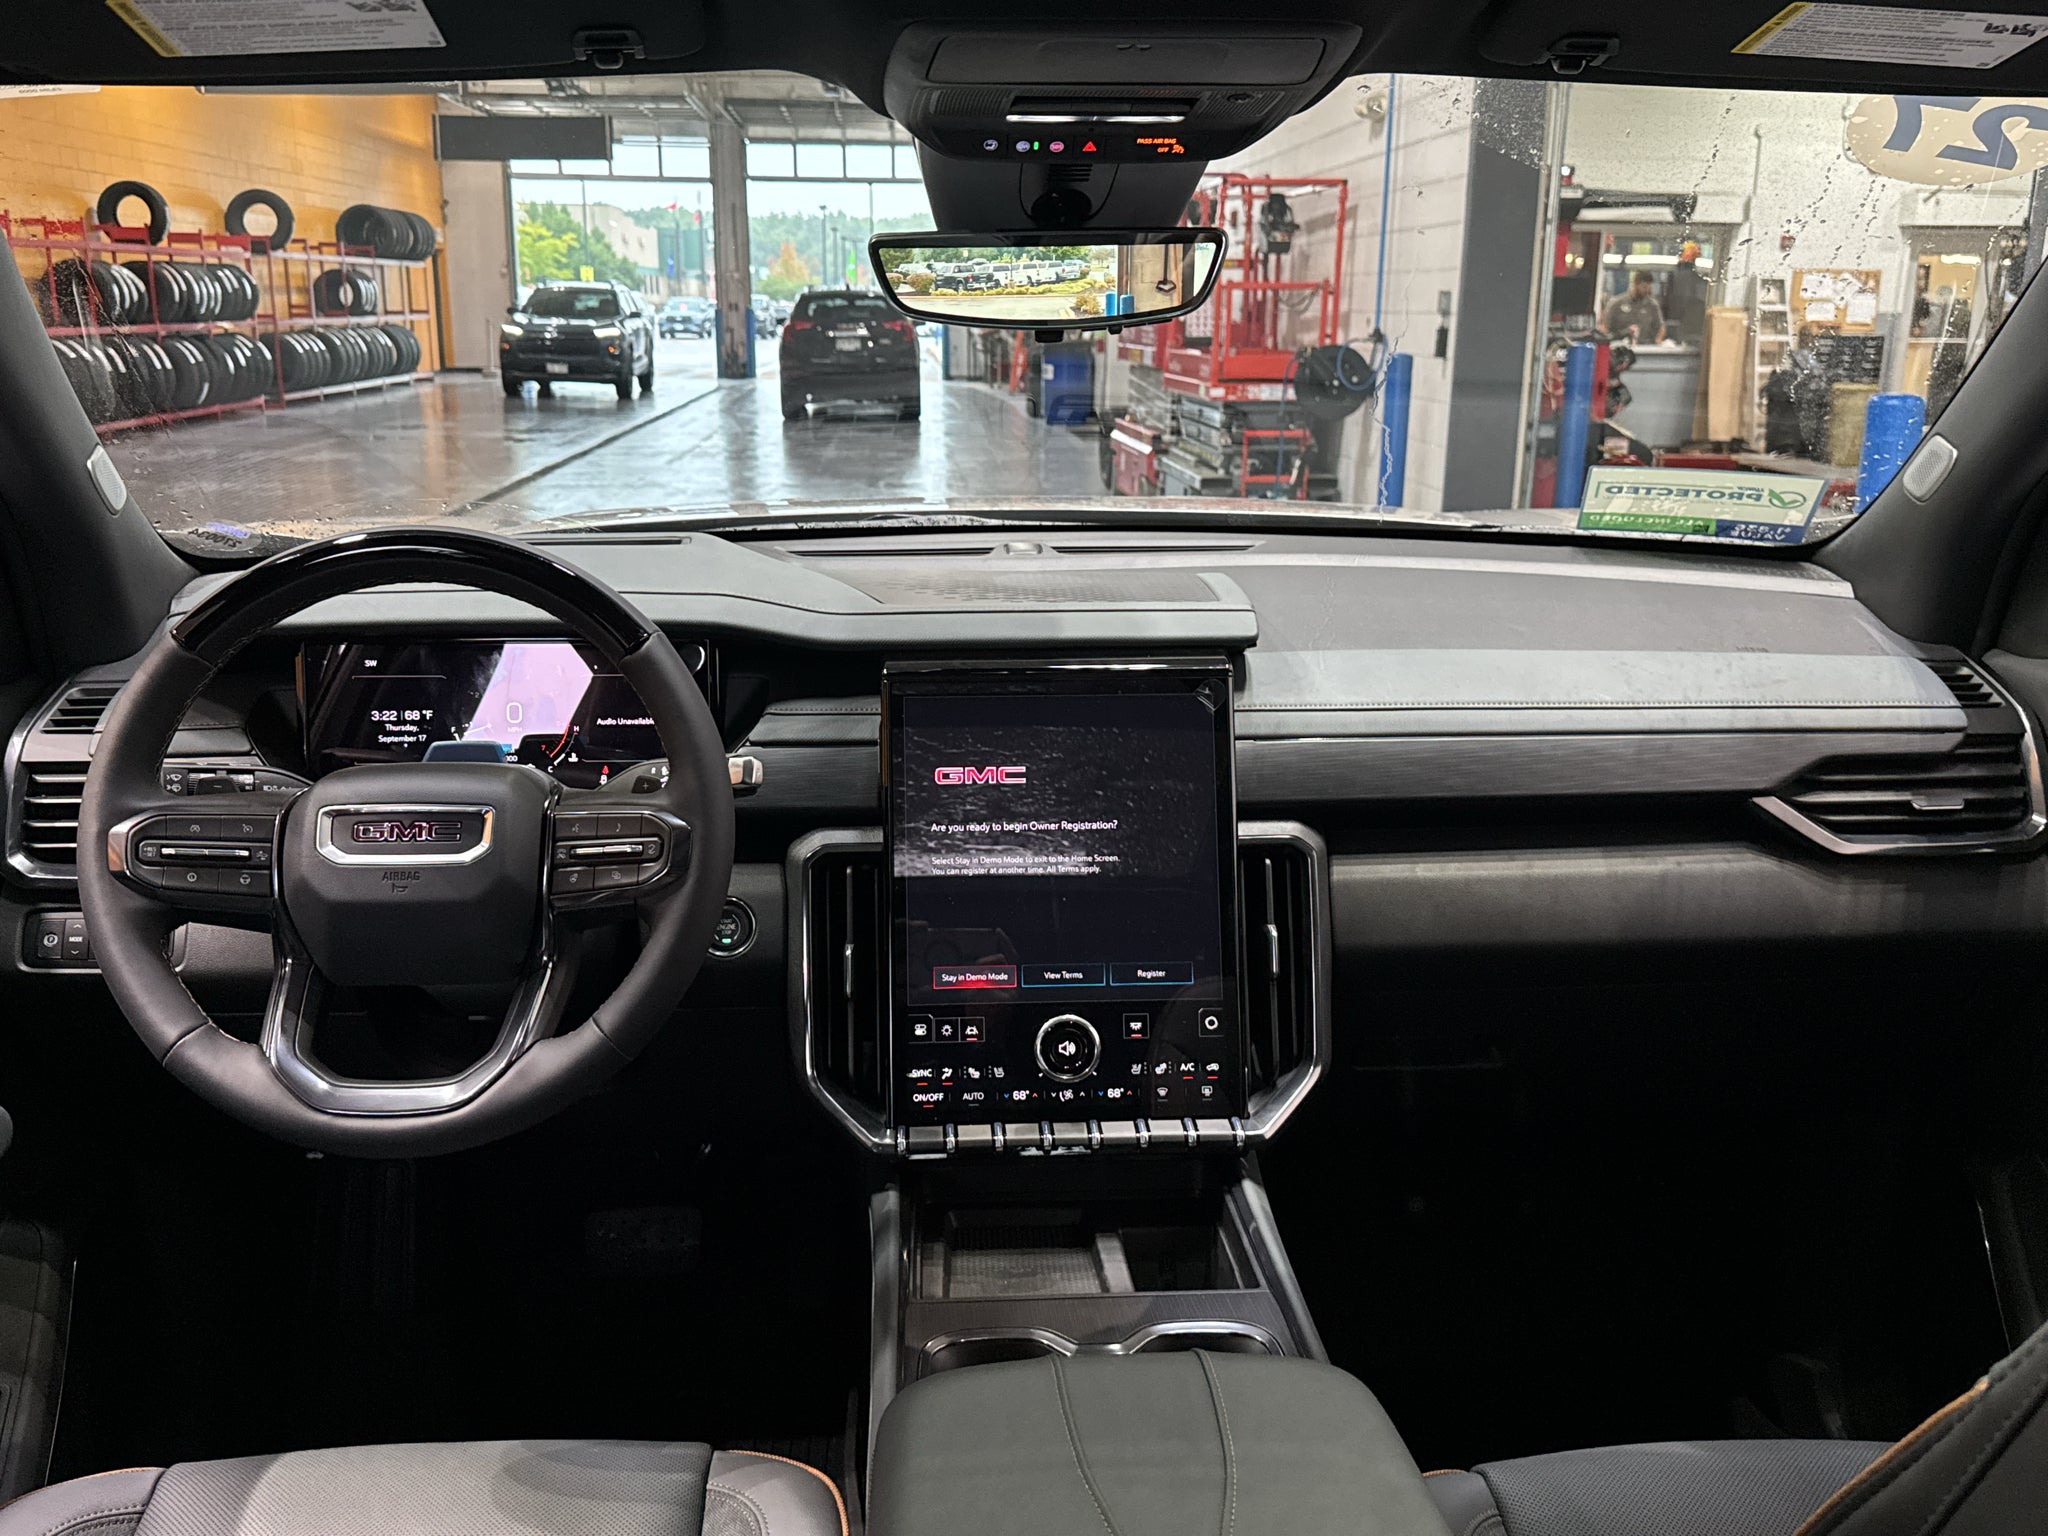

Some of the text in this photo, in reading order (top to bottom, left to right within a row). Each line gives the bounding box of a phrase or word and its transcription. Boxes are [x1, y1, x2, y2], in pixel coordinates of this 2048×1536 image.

[371, 710, 433, 721] 3:22 68 °F
[506, 702, 523, 723] 0
[597, 717, 617, 725] Audio
[378, 735, 416, 743] September
[935, 766, 1026, 785] GMC
[931, 820, 1118, 833] Are you ready to begin Owner Registration?
[354, 822, 461, 843] GMC
[955, 857, 970, 865] Stay
[1094, 854, 1120, 862] Screen.
[961, 867, 987, 876] register
[998, 866, 1025, 874] another
[1081, 865, 1101, 874] apply.
[382, 871, 420, 881] AIRBAG
[941, 974, 957, 983] Stay
[988, 972, 1008, 980] Mode
[1062, 971, 1083, 979] Terms
[1137, 969, 1166, 979] Register
[1180, 1063, 1195, 1071] A/C
[911, 1069, 932, 1077] SYNC
[913, 1093, 944, 1102] ON/OFF
[963, 1092, 984, 1100] AUTO
